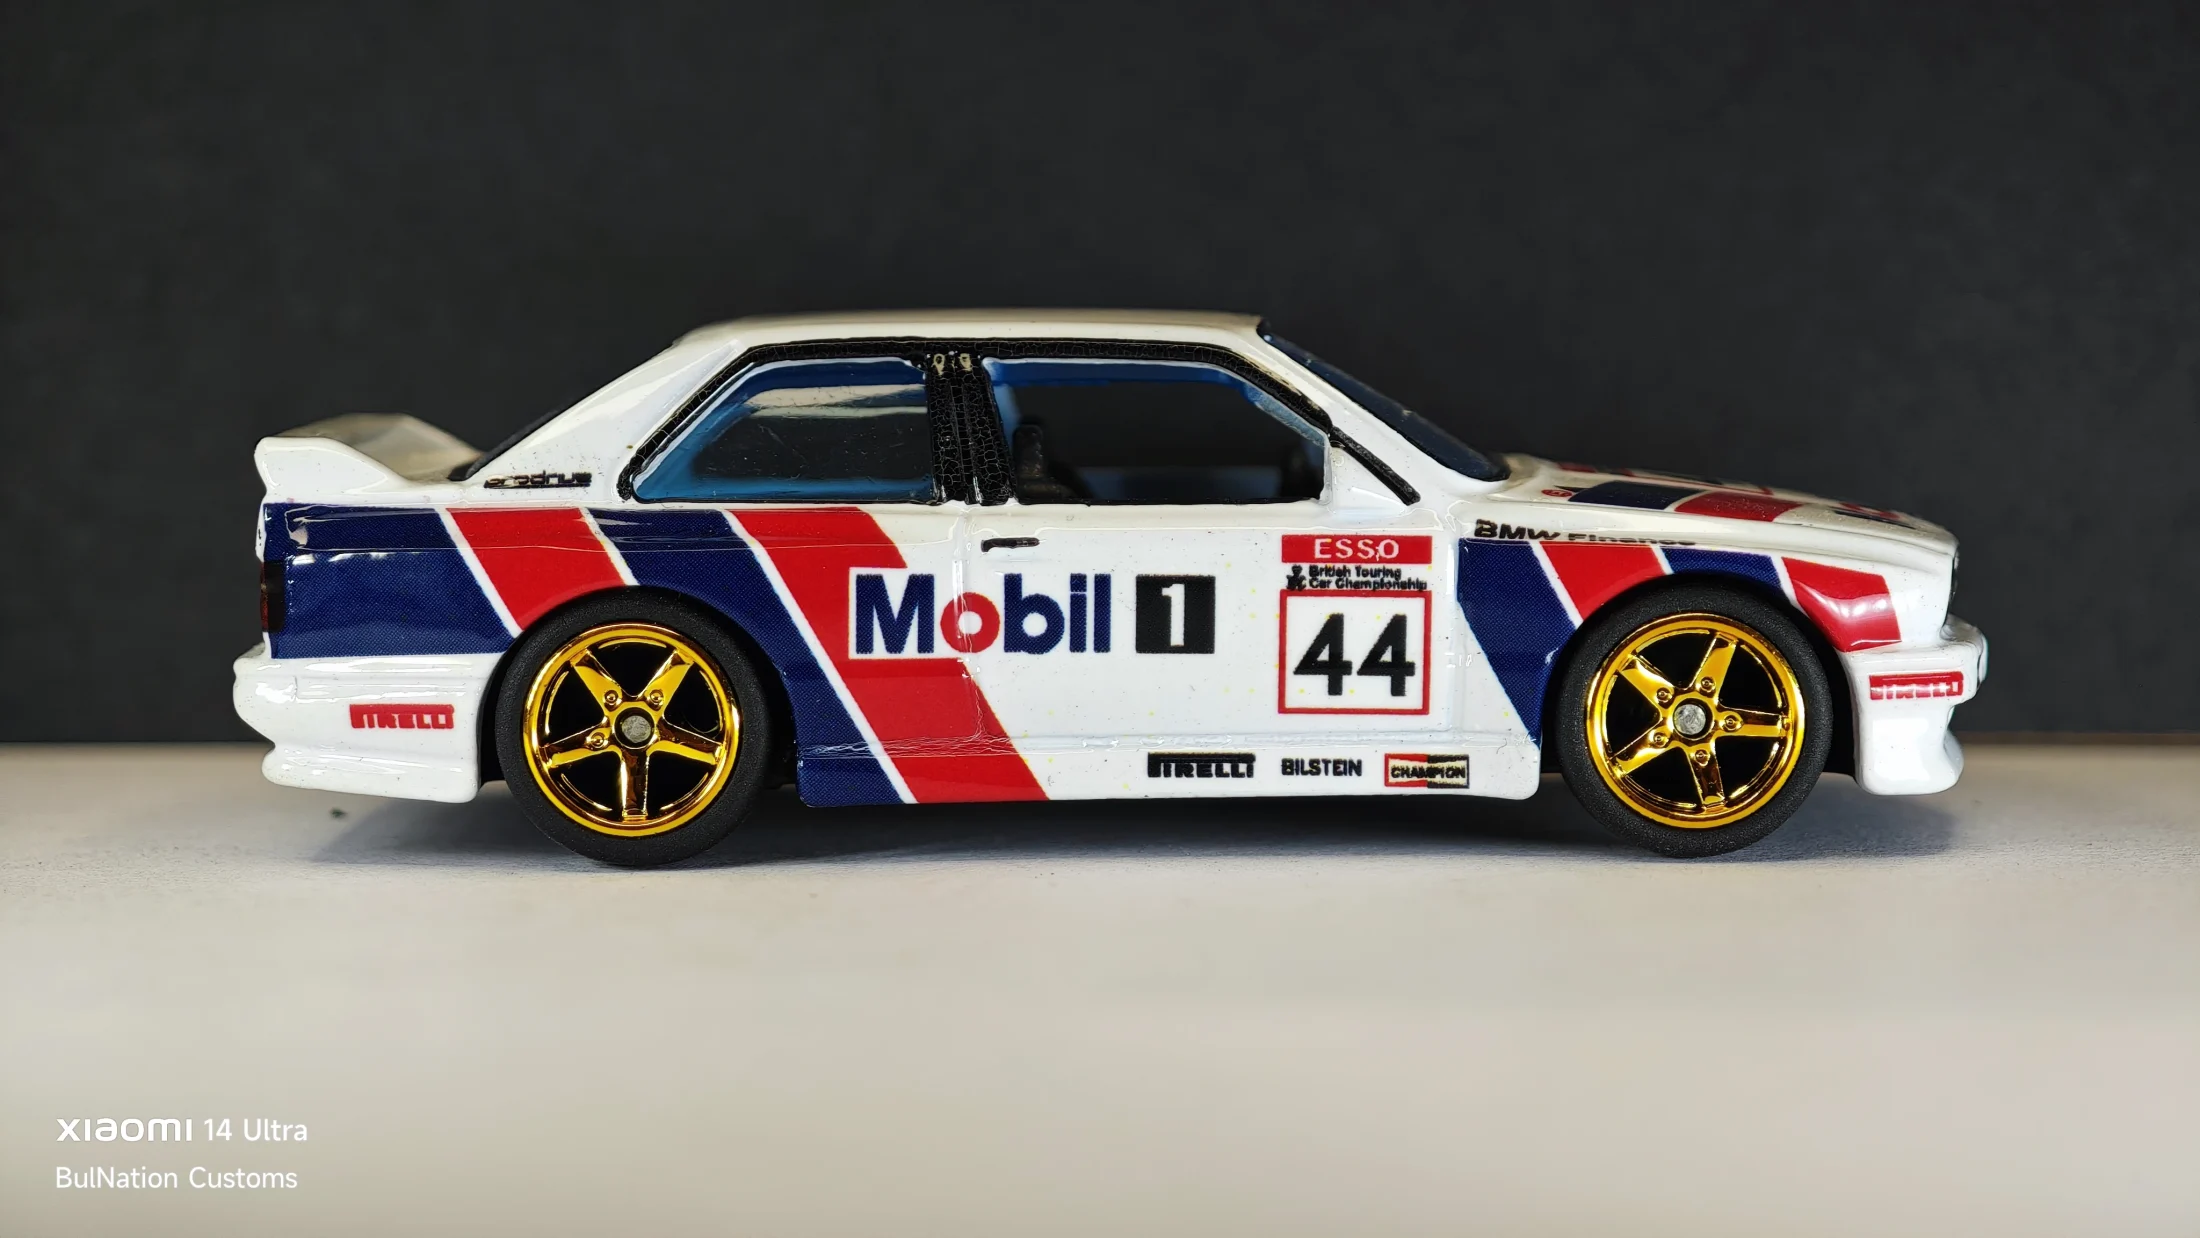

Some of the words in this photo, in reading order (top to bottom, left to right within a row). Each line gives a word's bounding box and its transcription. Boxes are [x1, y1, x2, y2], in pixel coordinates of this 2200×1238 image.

[1474, 519, 1560, 541] BMW
[1314, 538, 1400, 560] ESSO
[1309, 564, 1351, 577] British
[1355, 565, 1402, 579] Touring
[1309, 577, 1332, 589] Car
[1335, 577, 1427, 591] Championship
[855, 573, 1112, 655] Mobil
[1160, 583, 1186, 648] 1
[1293, 612, 1416, 697] 44
[1147, 752, 1256, 778] PIRELLI
[1281, 758, 1362, 777] BILSTEIN
[1391, 765, 1466, 779] CHAMPION
